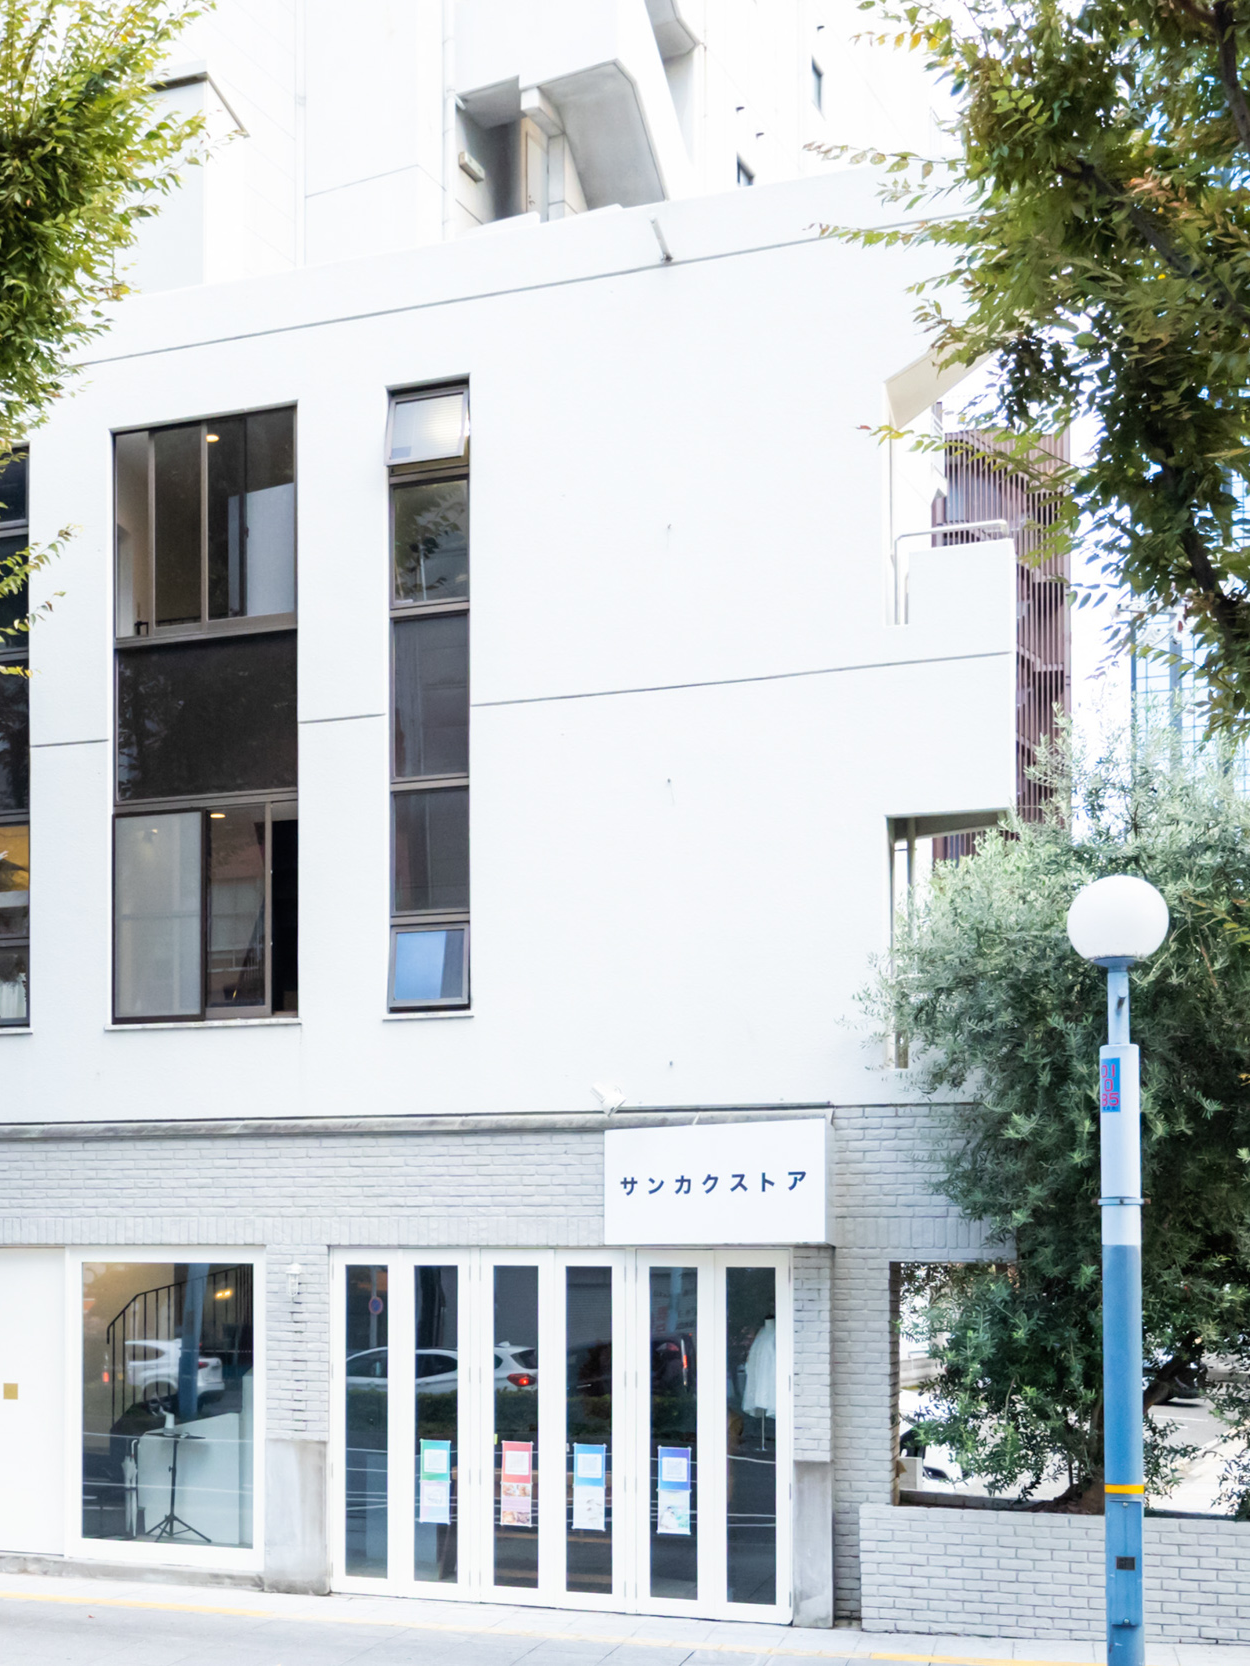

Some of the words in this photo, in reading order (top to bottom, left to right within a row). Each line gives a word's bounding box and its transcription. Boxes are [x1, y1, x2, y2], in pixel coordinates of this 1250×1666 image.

[620, 1171, 807, 1196] サンカクストア
